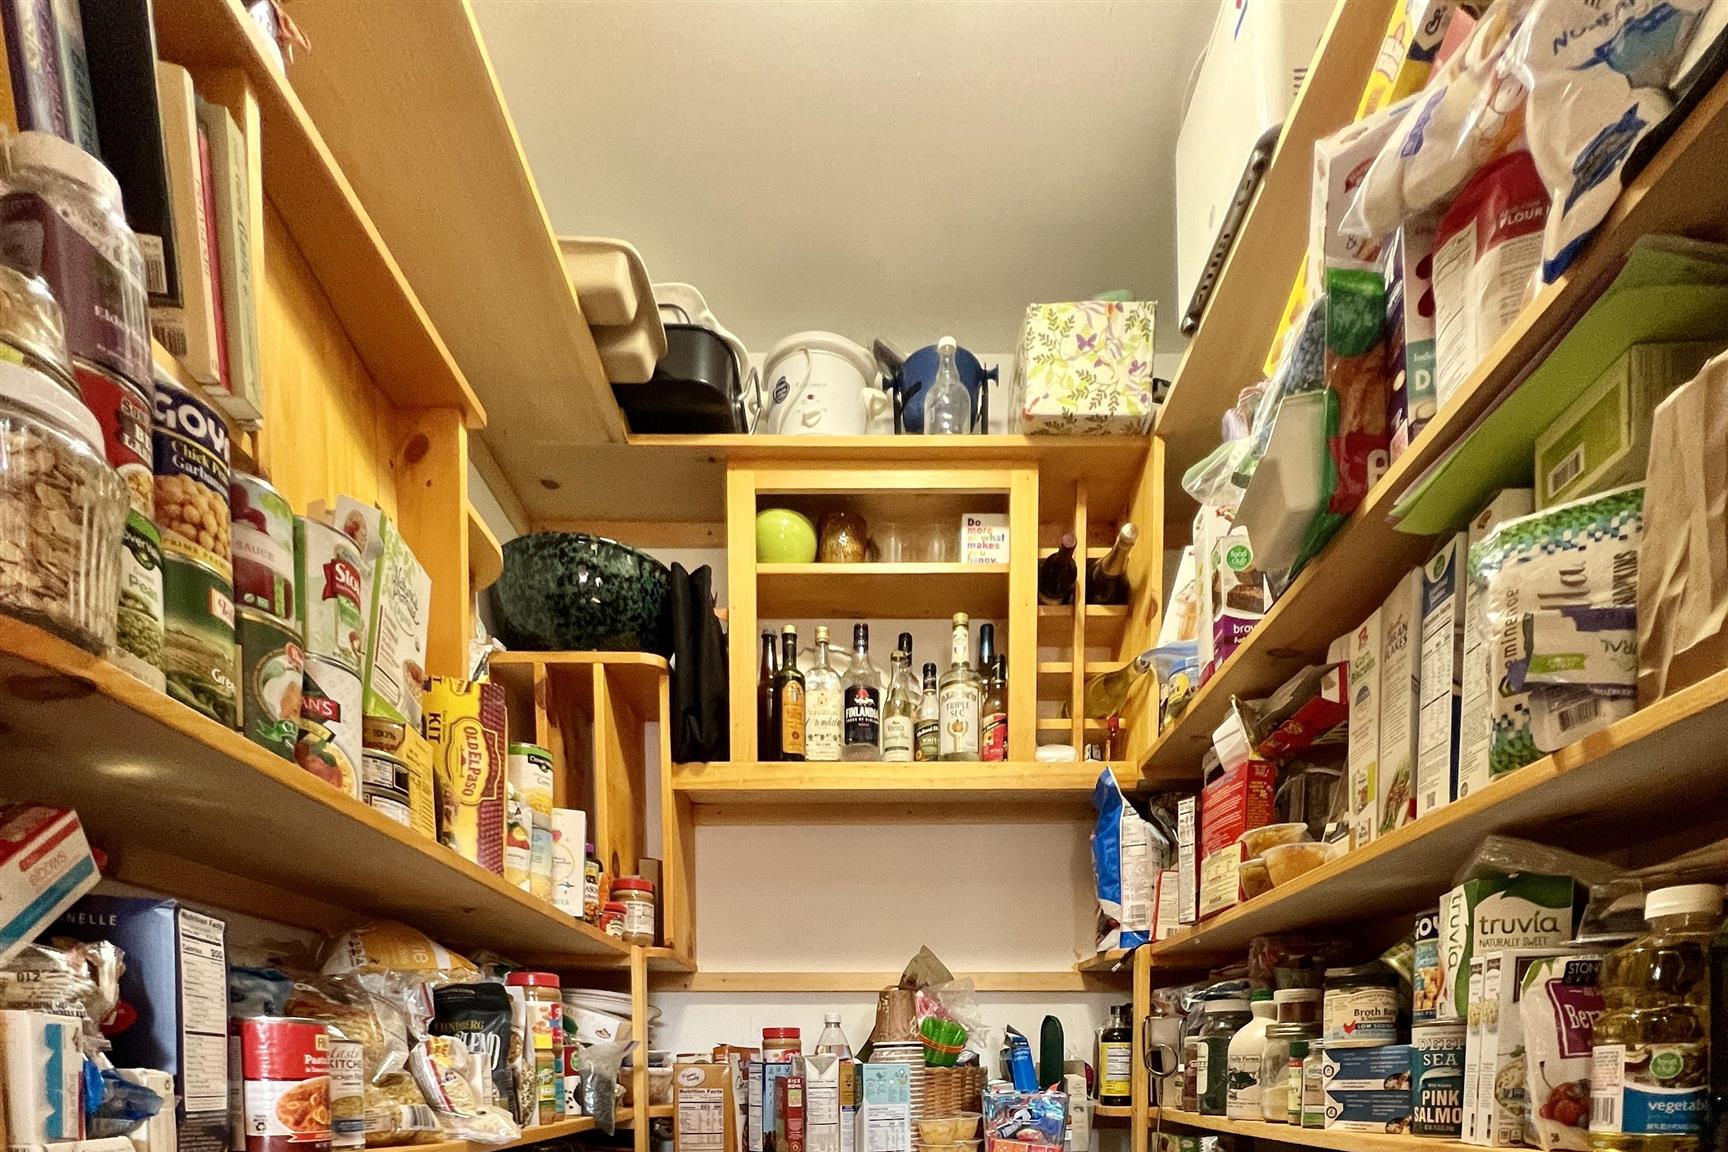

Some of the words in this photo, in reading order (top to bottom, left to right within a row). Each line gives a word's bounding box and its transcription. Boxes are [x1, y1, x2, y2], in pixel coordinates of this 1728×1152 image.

[967, 517, 982, 527] Do
[967, 527, 993, 535] more
[981, 533, 1005, 542] what
[967, 541, 1000, 550] makes
[1230, 549, 1248, 557] food
[1502, 587, 1519, 669] eminence
[428, 711, 442, 745] KIT
[463, 726, 478, 751] OLD
[466, 751, 482, 767] EL
[65, 912, 119, 927] NELLE
[1479, 937, 1520, 948] NATURALLY
[1522, 936, 1548, 947] SWEET
[1354, 1008, 1381, 1017] Broth
[1423, 1053, 1458, 1067] SEA
[1422, 1090, 1460, 1106] PINK
[1413, 1106, 1463, 1125] SALMO
